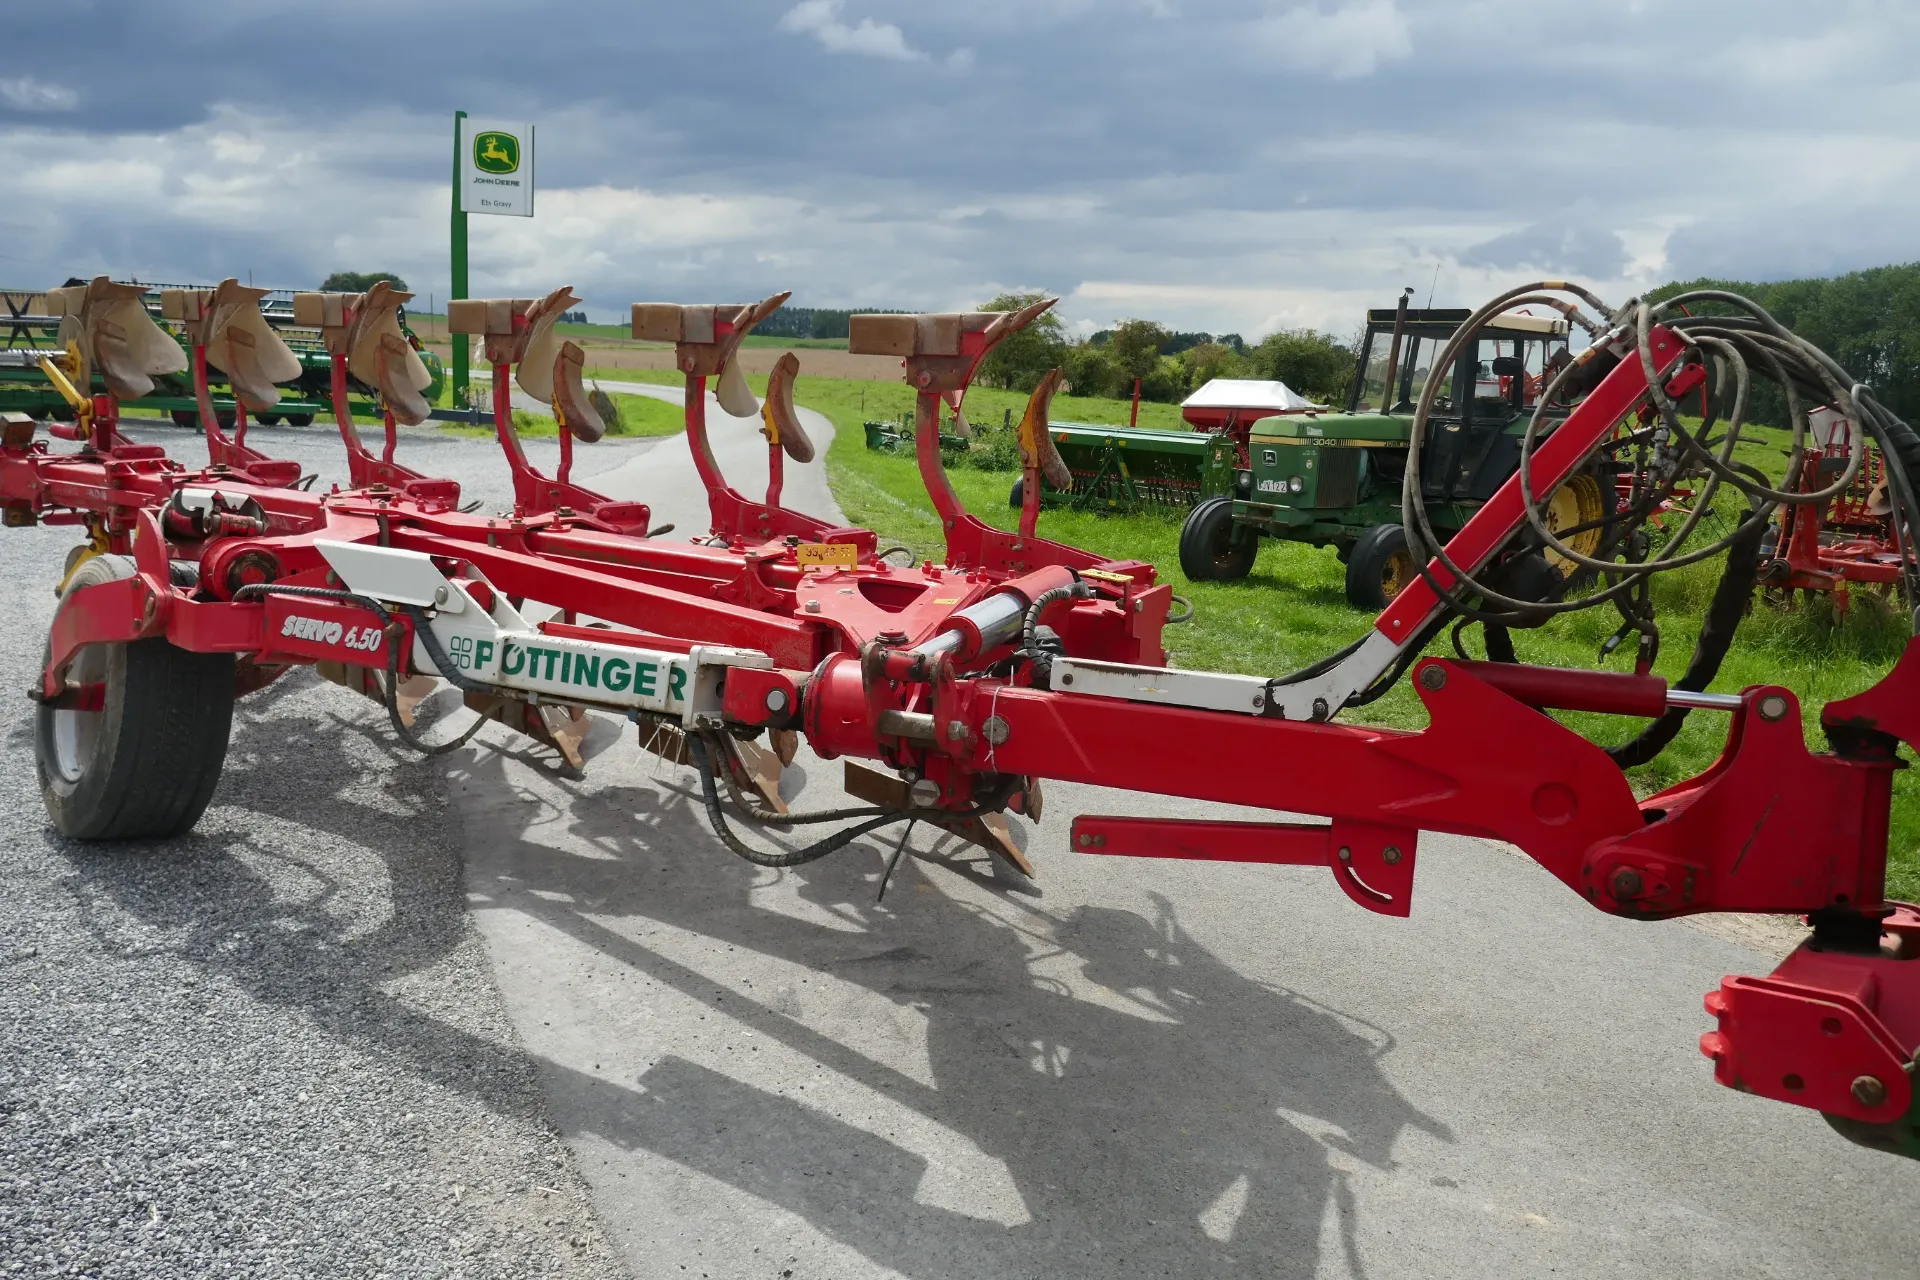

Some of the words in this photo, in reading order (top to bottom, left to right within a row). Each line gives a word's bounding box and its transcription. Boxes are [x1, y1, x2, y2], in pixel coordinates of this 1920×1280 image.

[495, 178, 520, 186] DEERE
[1312, 438, 1336, 446] 3040
[281, 615, 343, 645] SERVO
[344, 626, 382, 652] 6.50
